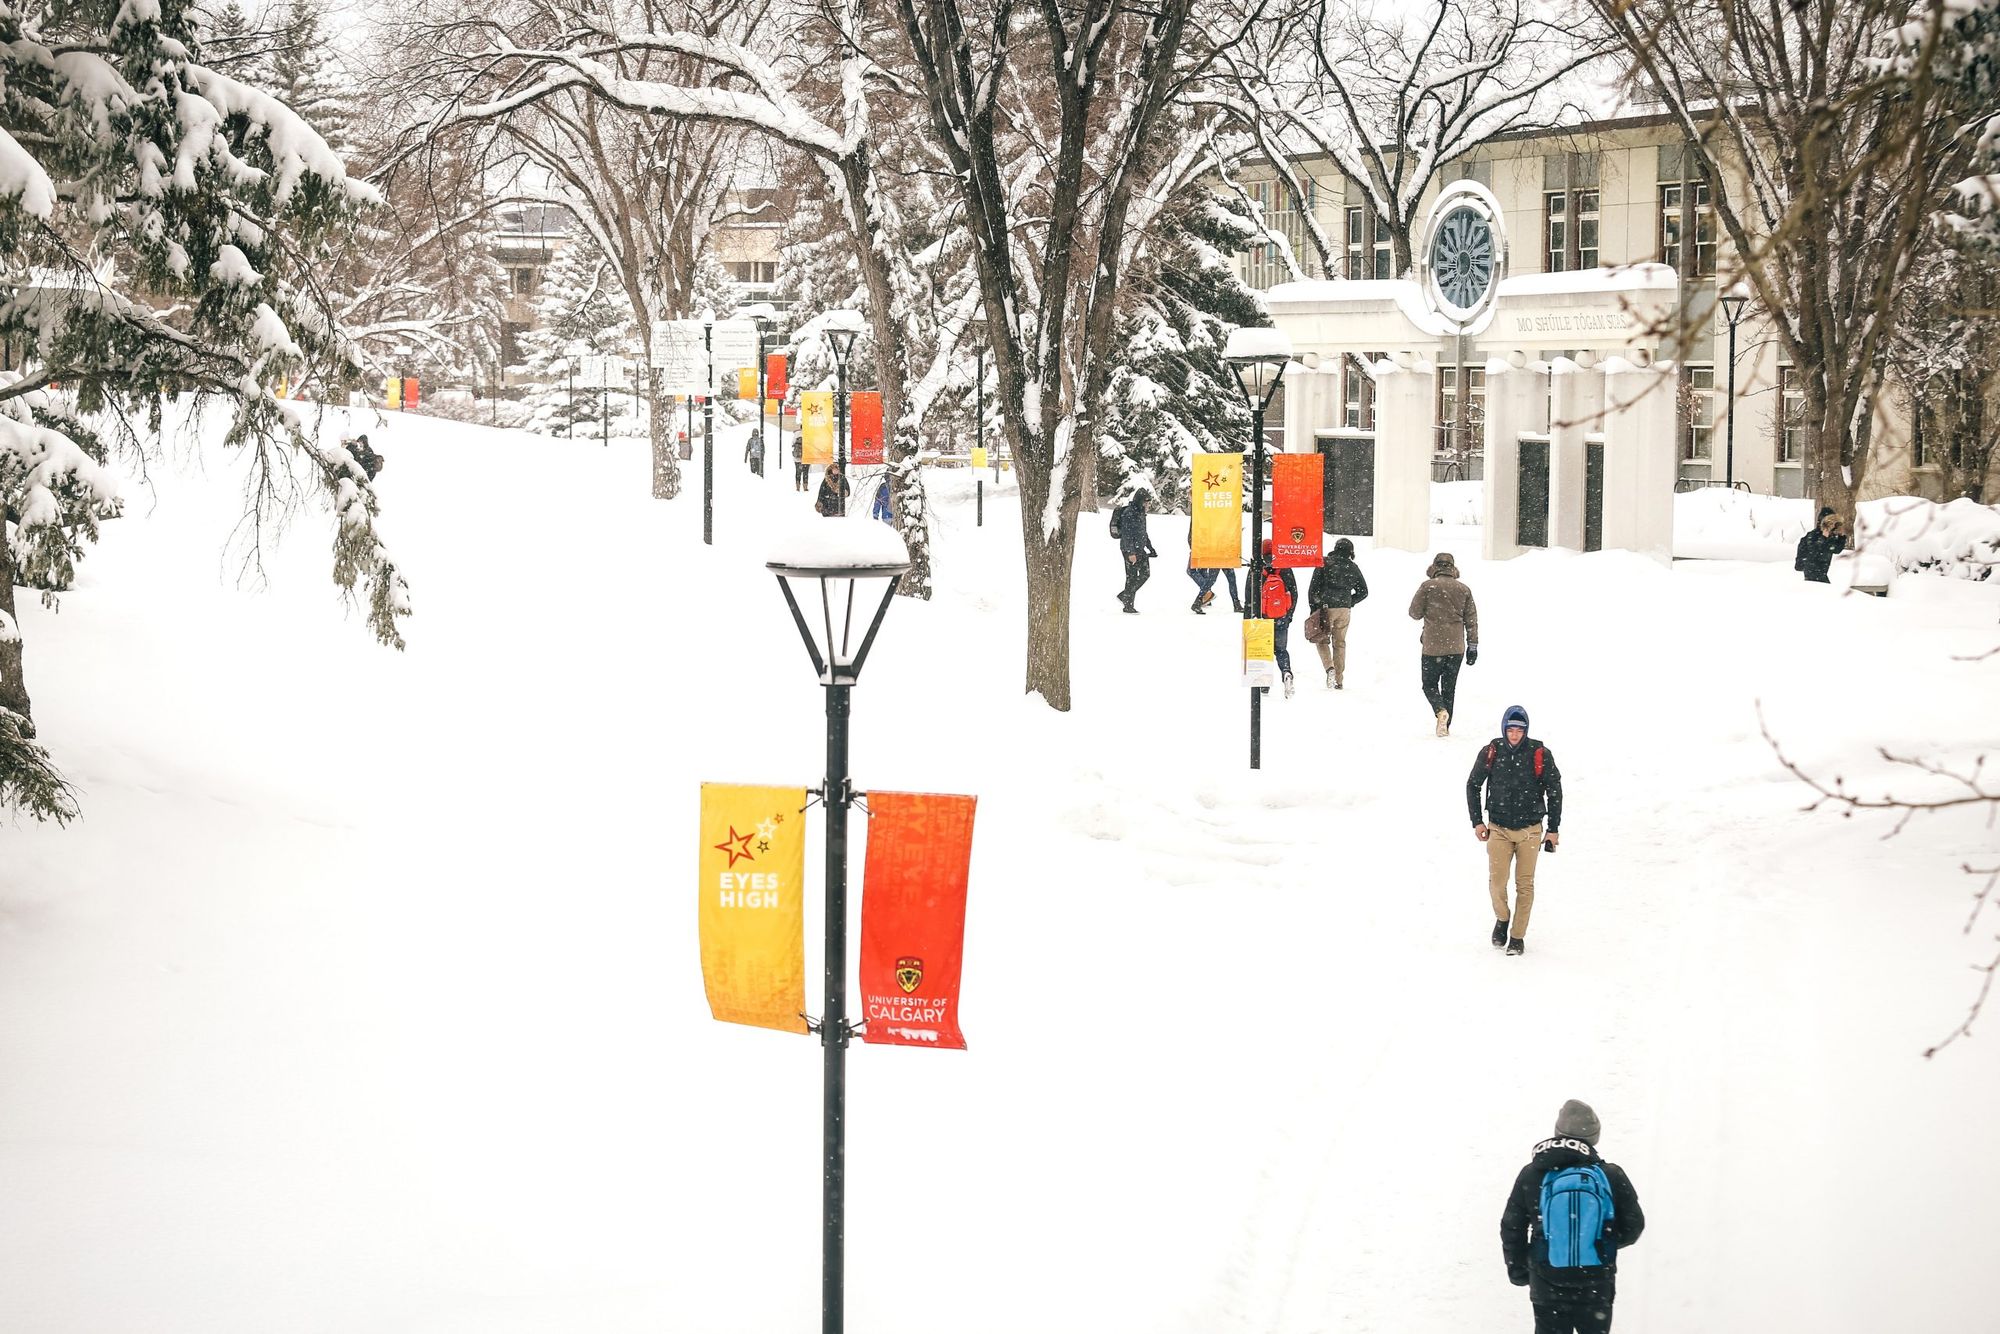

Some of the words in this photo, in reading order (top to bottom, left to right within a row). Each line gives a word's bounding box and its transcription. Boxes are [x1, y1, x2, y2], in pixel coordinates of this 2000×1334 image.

[1516, 317, 1533, 332] MO
[1535, 314, 1572, 332] SHÚILE
[1203, 491, 1233, 500] EYES
[1203, 500, 1233, 509] HIGH
[720, 872, 779, 890] EYES
[720, 890, 779, 908] HIGH
[868, 994, 928, 1007] UNIVERSITY
[932, 998, 947, 1007] OF
[869, 1005, 946, 1022] CALGARY
